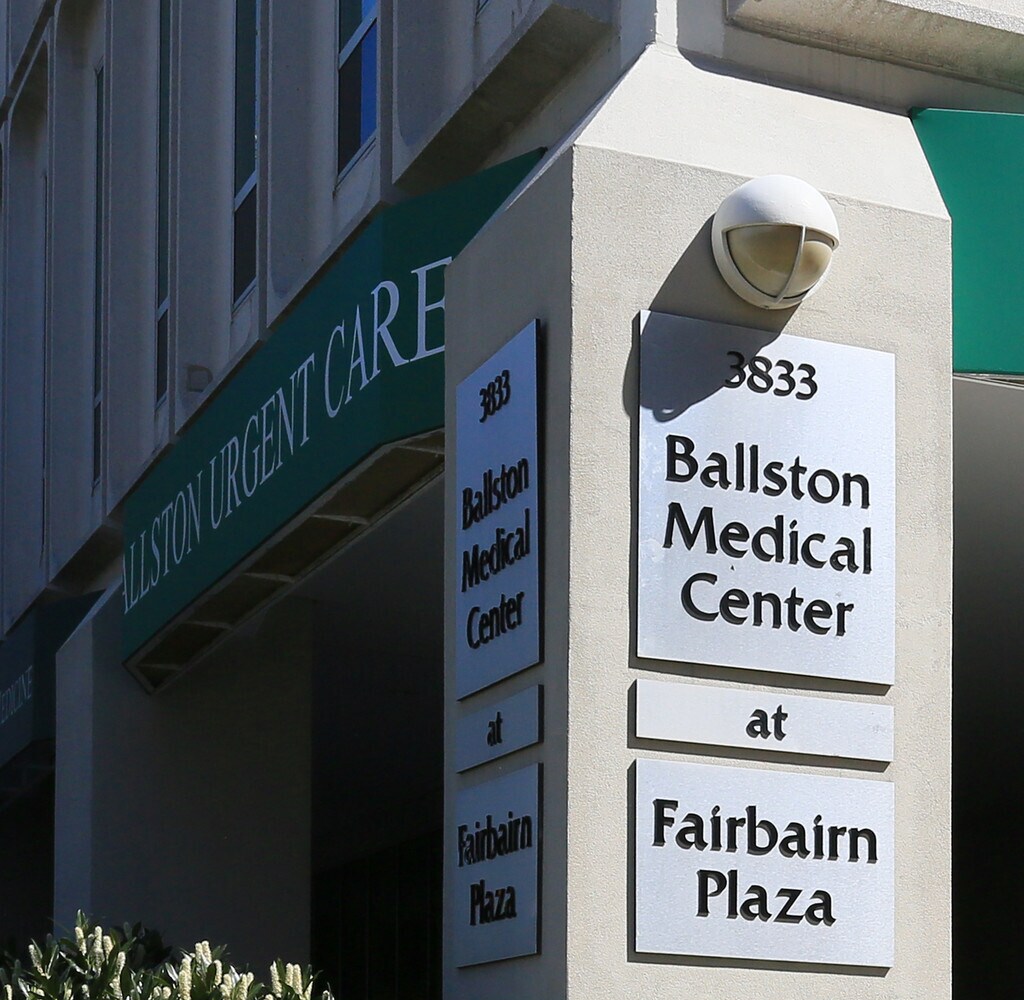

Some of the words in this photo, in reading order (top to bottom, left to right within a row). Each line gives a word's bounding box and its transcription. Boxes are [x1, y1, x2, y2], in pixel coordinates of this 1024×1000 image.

[209, 352, 315, 530] URGENT
[324, 256, 453, 418] CARE
[479, 369, 511, 423] 3833
[725, 351, 818, 400] 3833
[462, 458, 529, 530] Ballston
[666, 434, 870, 509] Ballston
[461, 508, 530, 592] Medical
[663, 502, 872, 574] Medical
[467, 592, 525, 649] Center
[681, 572, 854, 636] Center
[487, 712, 503, 746] at
[746, 705, 788, 741] at
[458, 811, 532, 867] Fairbairn
[652, 799, 878, 863] Fairbairn
[470, 879, 517, 926] Plaza
[696, 869, 837, 926] Plaza
